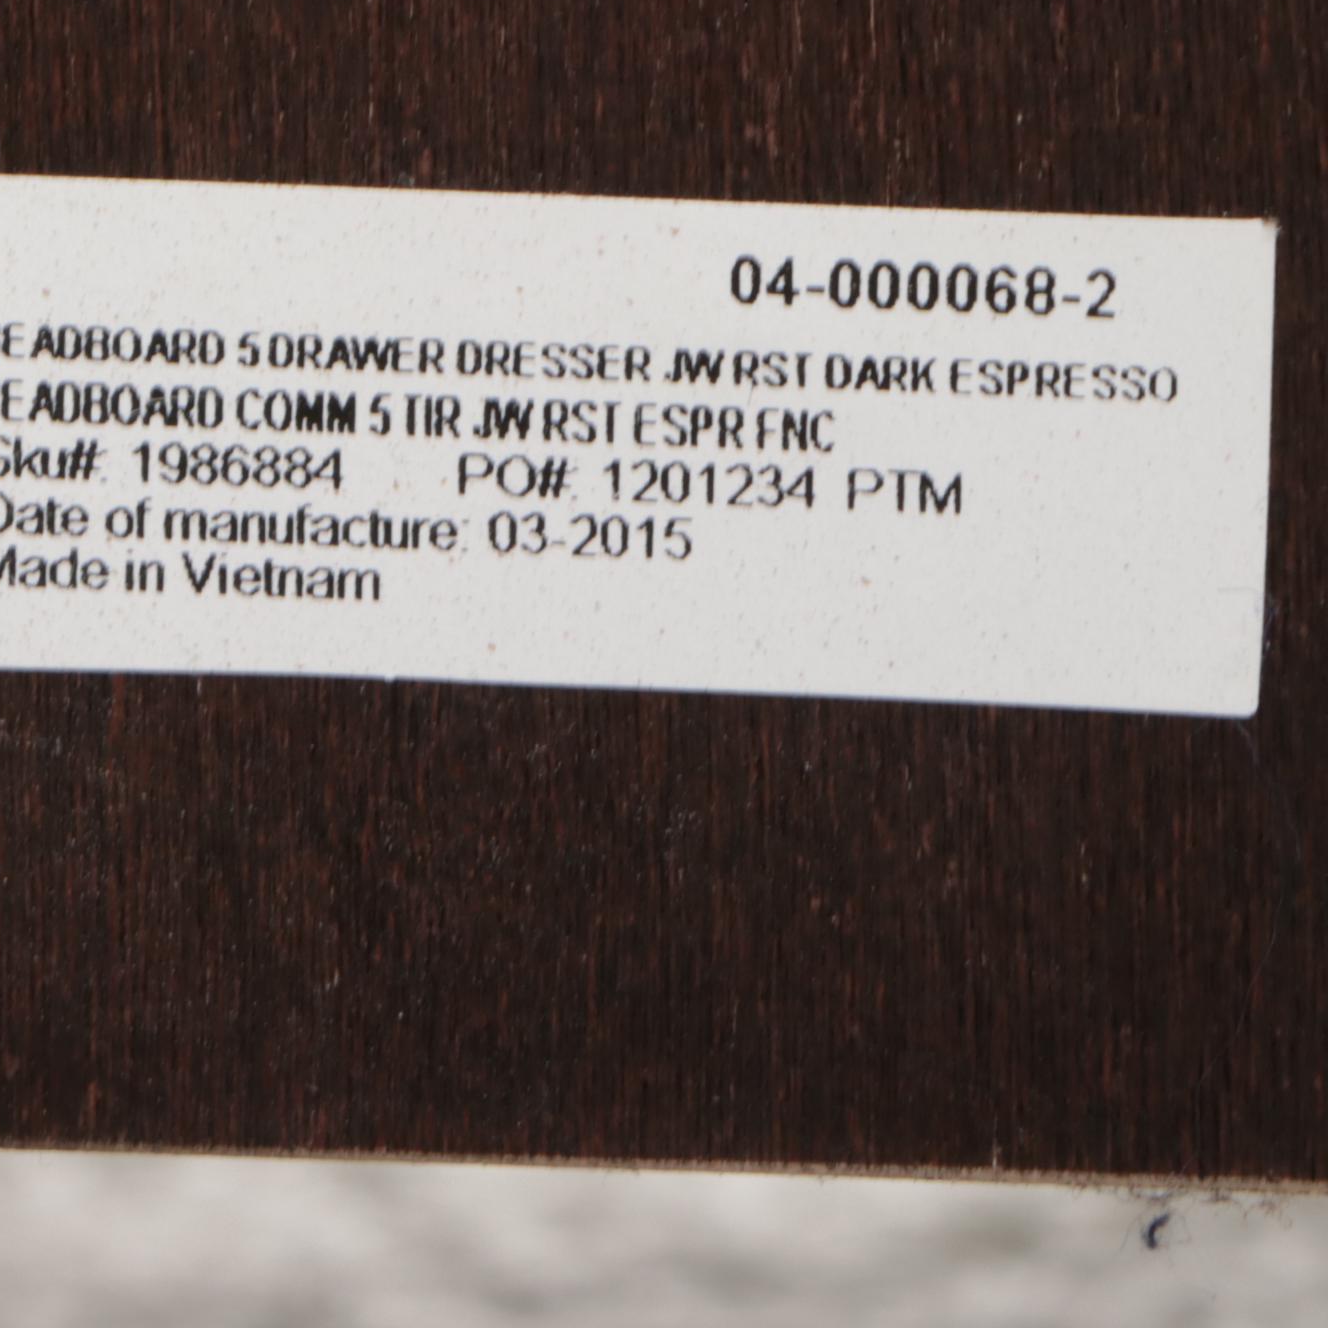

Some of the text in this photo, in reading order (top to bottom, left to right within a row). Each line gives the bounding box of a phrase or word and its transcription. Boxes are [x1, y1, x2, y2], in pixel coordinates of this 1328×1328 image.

[729, 254, 1118, 320] 04-000068-2
[455, 339, 652, 383] DRESSER
[823, 353, 937, 394] DARK
[948, 359, 1179, 404] ESPRESSO
[234, 388, 358, 435] COMM
[368, 392, 392, 436] 5
[403, 394, 462, 439] TIR
[632, 402, 746, 450] ESPR
[755, 407, 835, 454] FNC
[132, 441, 344, 491] 1986884
[604, 458, 816, 509] 1201234
[846, 469, 963, 515] PTM
[104, 499, 154, 540] of
[162, 505, 469, 552] manufacture:
[486, 511, 694, 561] 03-2015
[124, 551, 166, 593] in
[181, 552, 382, 602] Vietnam
